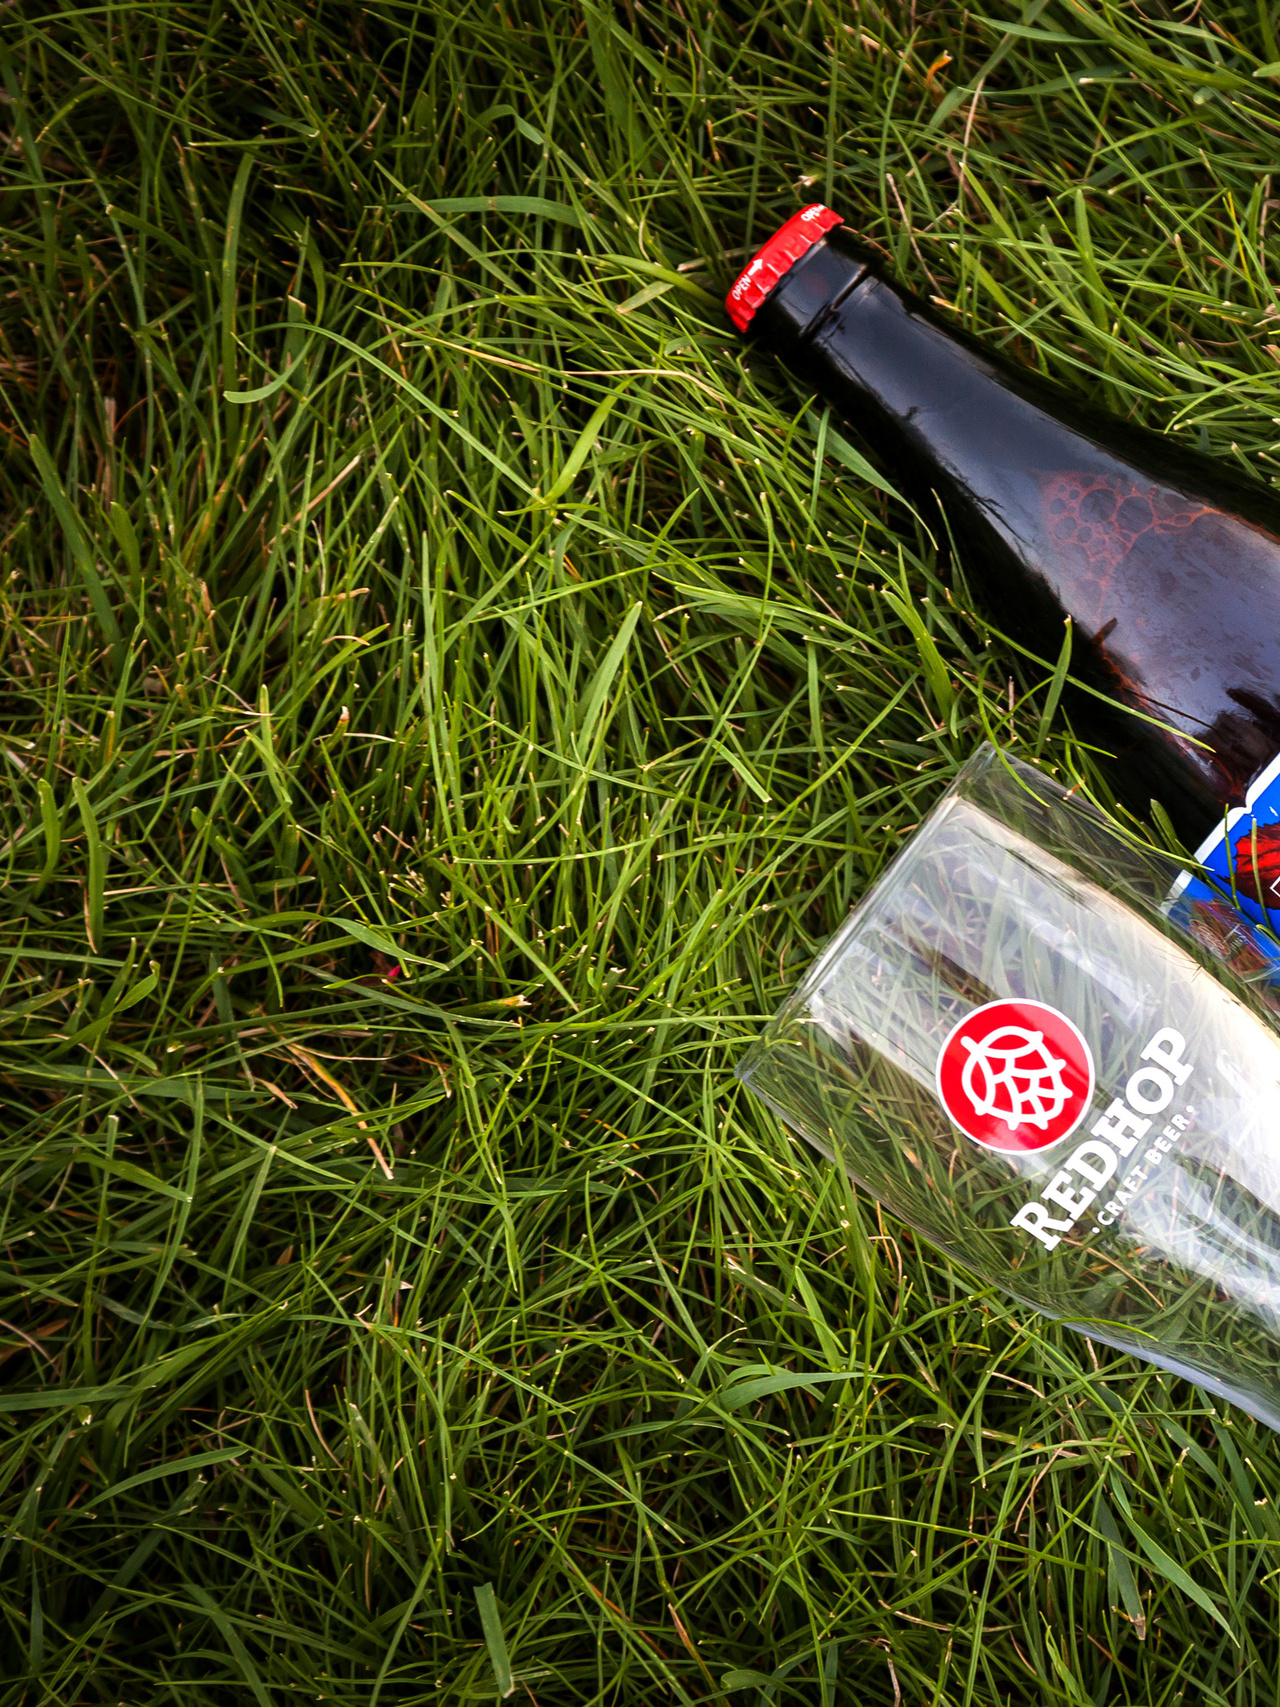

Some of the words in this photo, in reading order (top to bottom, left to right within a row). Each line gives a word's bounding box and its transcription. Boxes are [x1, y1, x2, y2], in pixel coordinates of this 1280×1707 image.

[731, 274, 751, 301] OPEN
[1010, 1026, 1194, 1251] REDHOP
[1097, 1165, 1148, 1226] CRAFT
[1144, 1113, 1190, 1165] BEER
